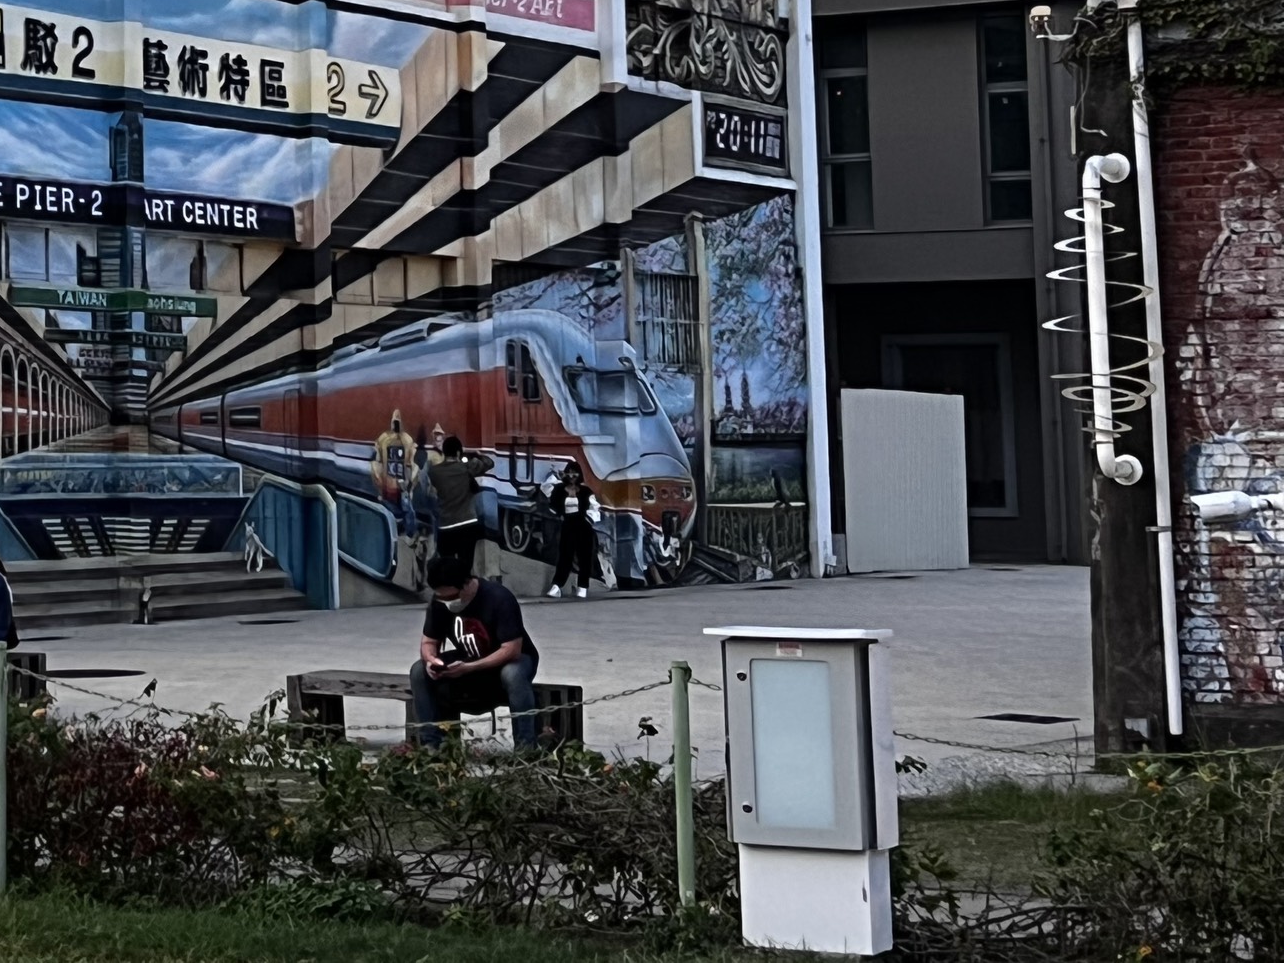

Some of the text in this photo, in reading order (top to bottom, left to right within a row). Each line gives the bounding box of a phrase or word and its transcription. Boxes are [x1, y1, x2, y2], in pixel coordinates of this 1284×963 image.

[327, 61, 347, 115] 2
[16, 183, 104, 217] PIER-2
[182, 201, 260, 230] CENTER
[56, 290, 107, 307] TAIWAN
